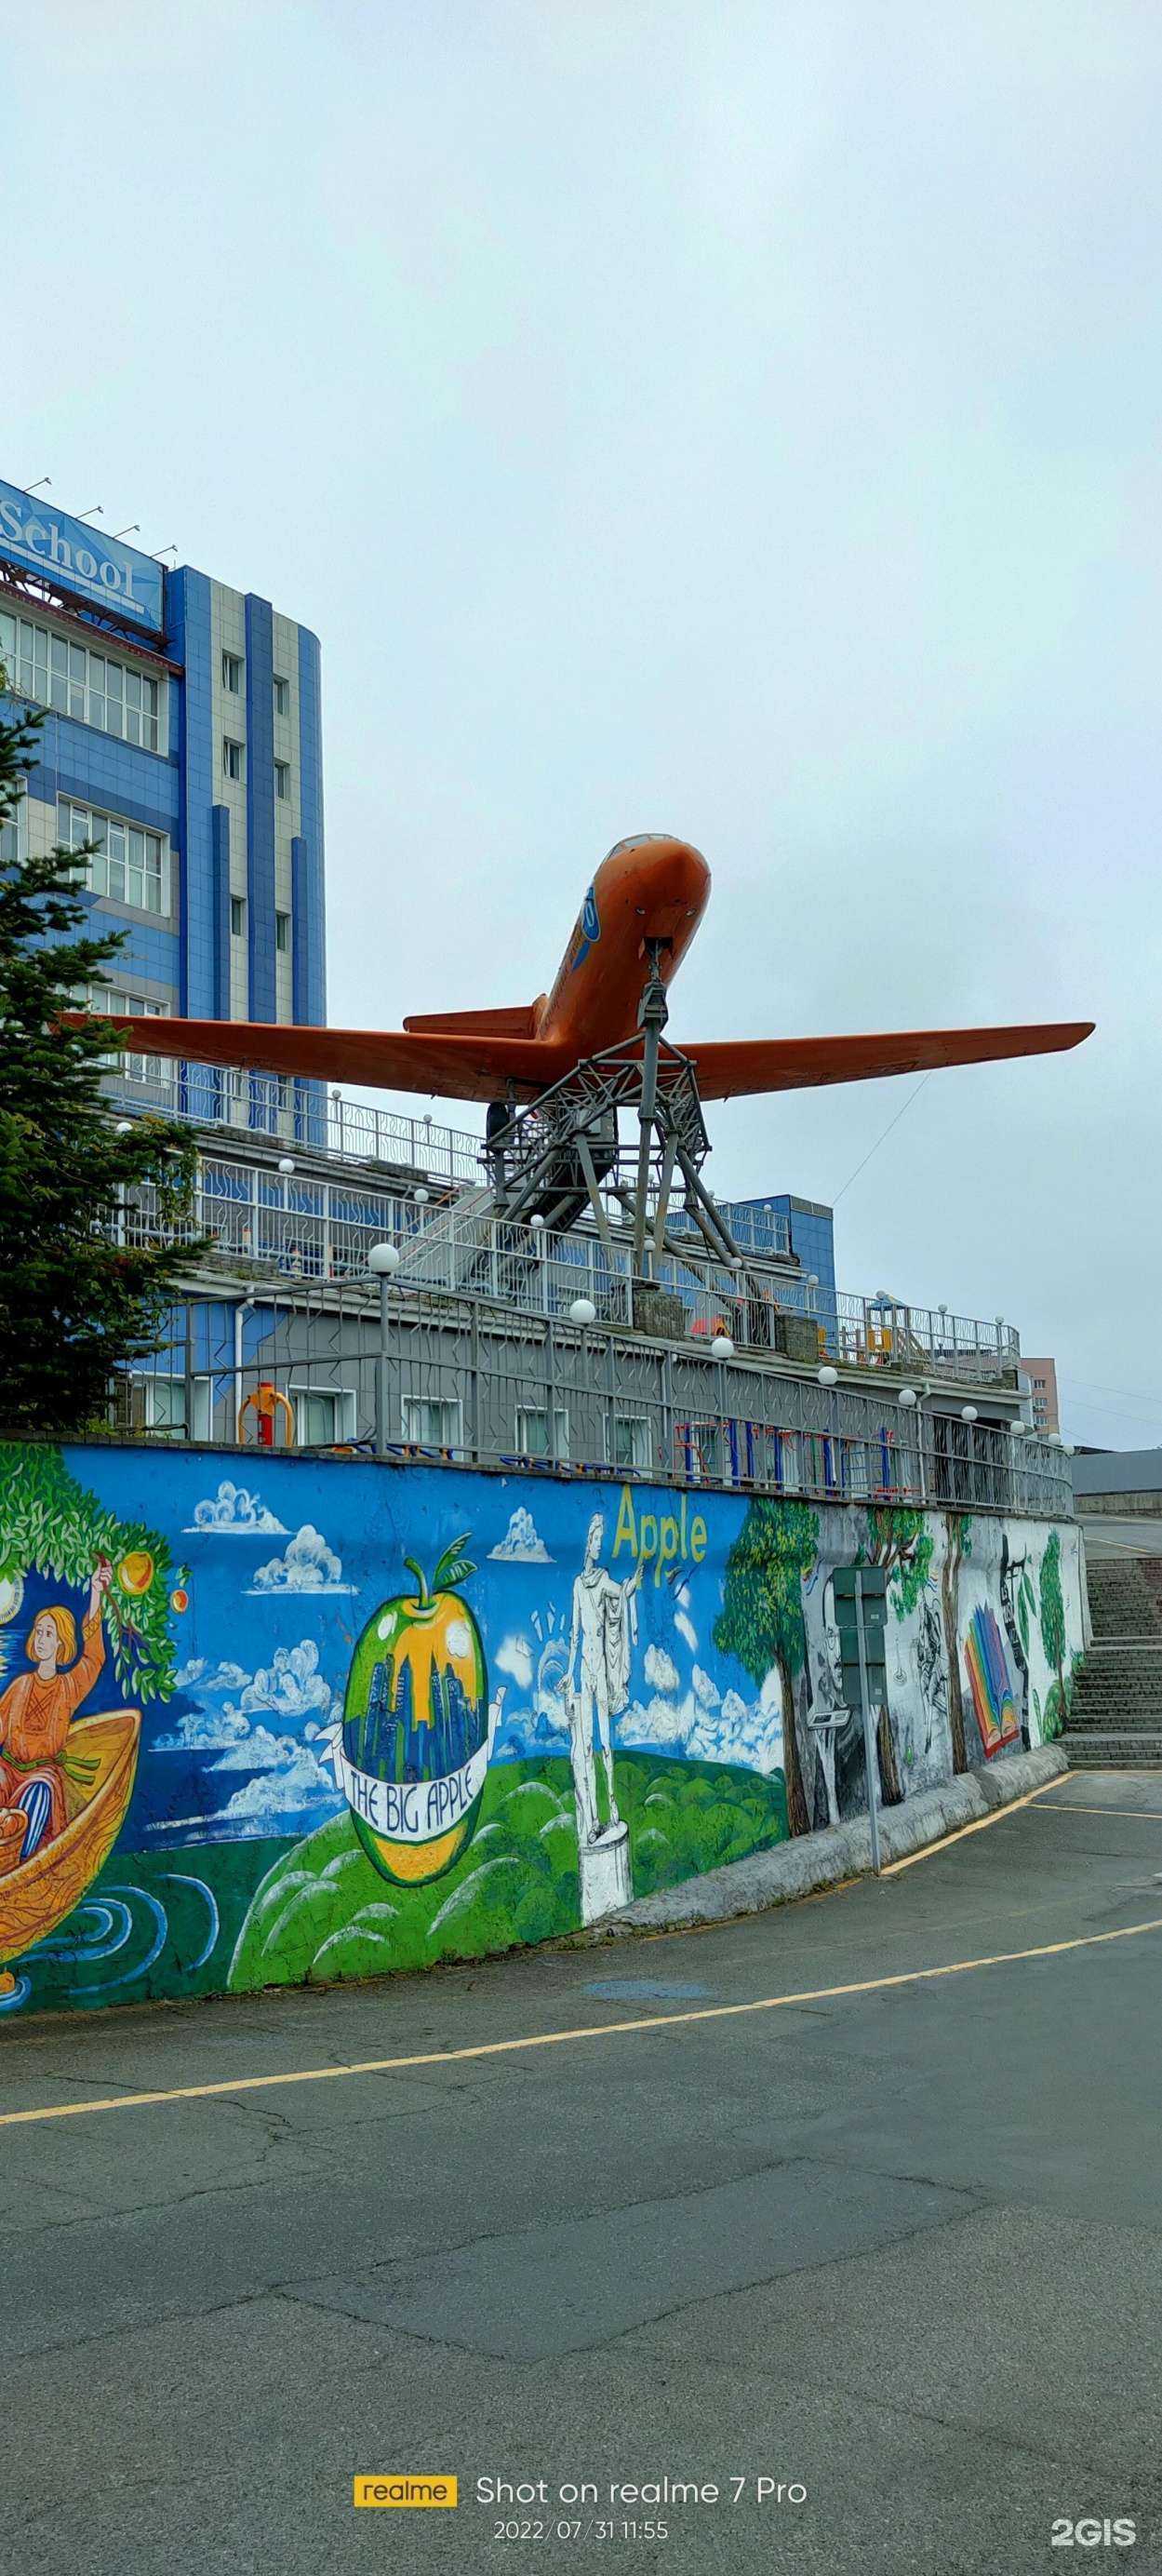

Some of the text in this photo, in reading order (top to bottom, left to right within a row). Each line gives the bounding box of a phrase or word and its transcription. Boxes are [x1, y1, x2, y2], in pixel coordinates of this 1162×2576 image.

[0, 500, 135, 600] School
[611, 1483, 707, 1590] Apple
[350, 1764, 474, 1833] THE BIG APPLE
